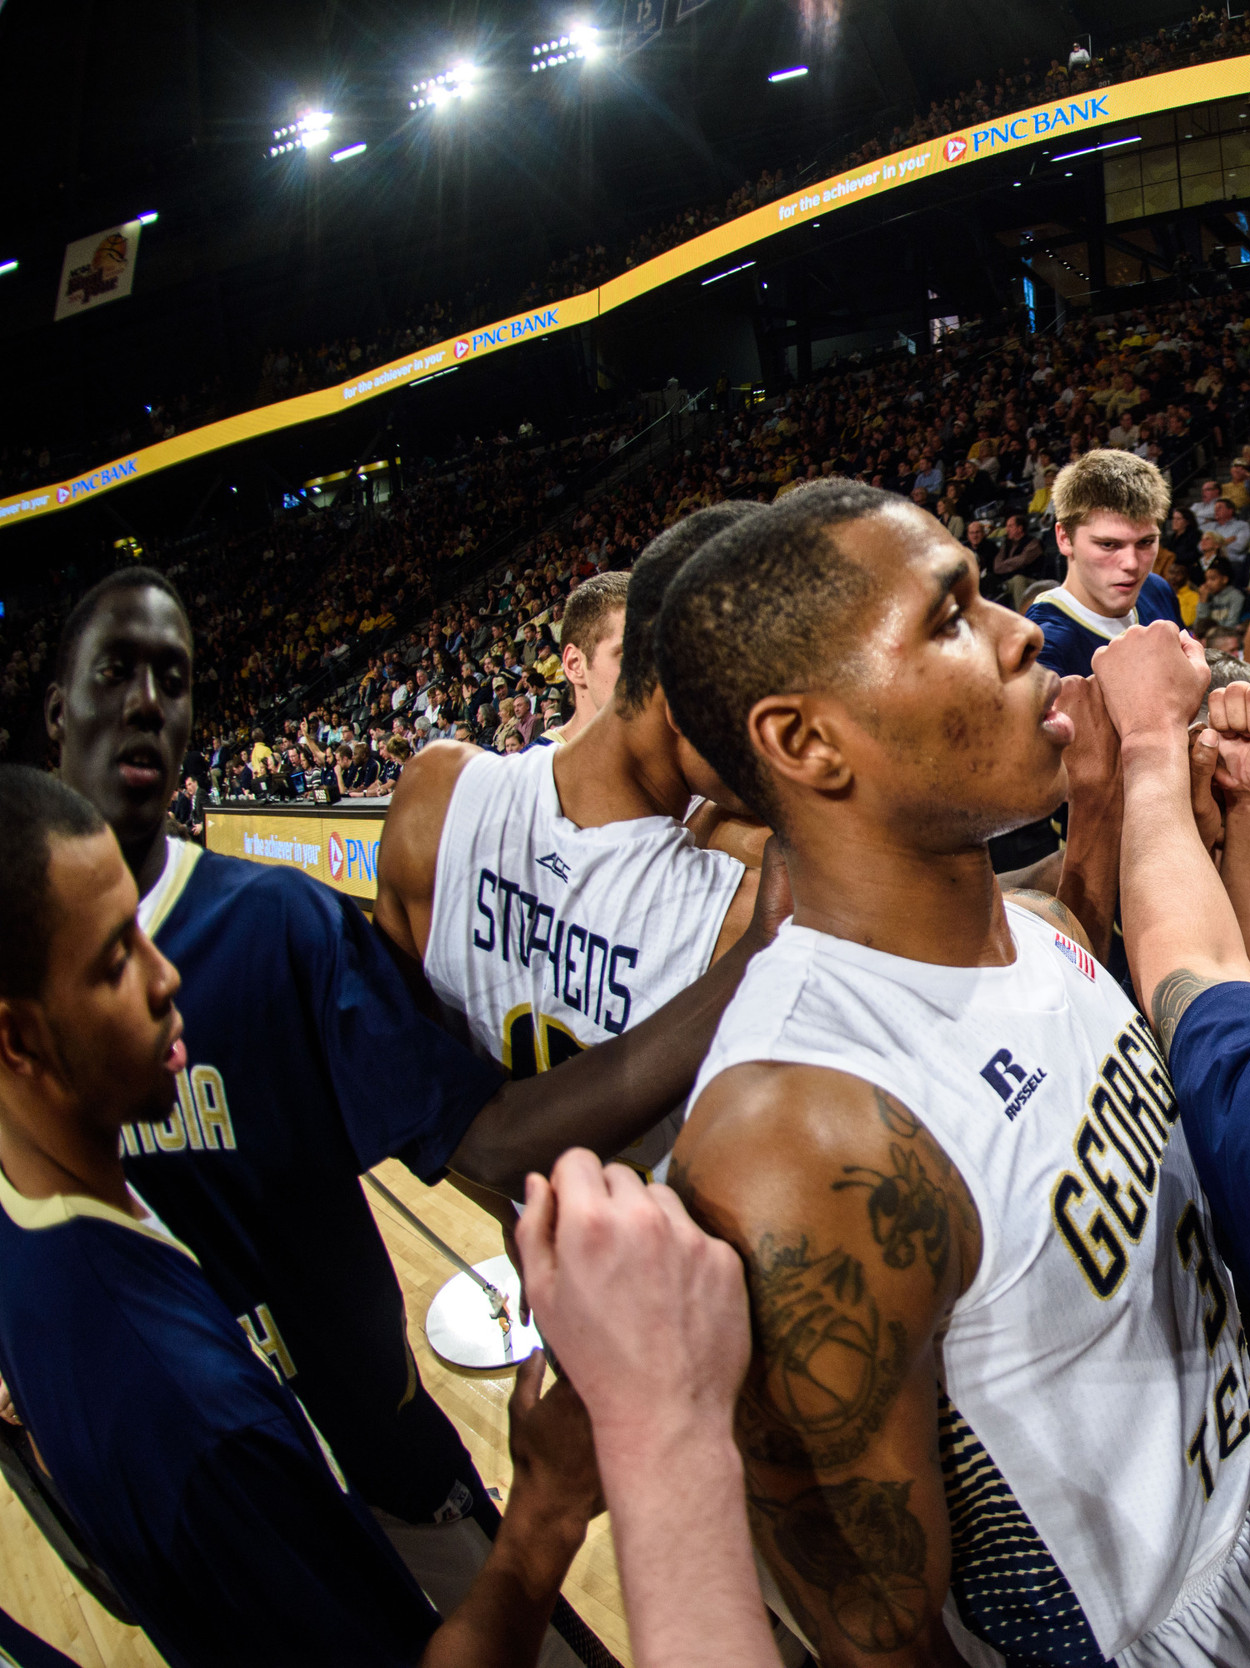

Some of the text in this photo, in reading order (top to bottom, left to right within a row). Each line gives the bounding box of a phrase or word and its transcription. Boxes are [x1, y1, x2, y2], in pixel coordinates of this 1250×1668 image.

[971, 95, 1109, 152] PNC BANK
[779, 203, 798, 221] for
[799, 194, 821, 212] the
[823, 170, 881, 203] achiever
[882, 164, 896, 180] in
[472, 308, 559, 351] PNC BANK
[343, 386, 357, 400] for
[357, 380, 373, 394] the
[374, 363, 413, 387] achiever
[413, 358, 424, 371] in
[71, 458, 138, 498] PNC BANK
[264, 835, 294, 860] achiever
[473, 868, 640, 1037] STEPHENS
[1003, 1066, 1048, 1123] RUSSELL
